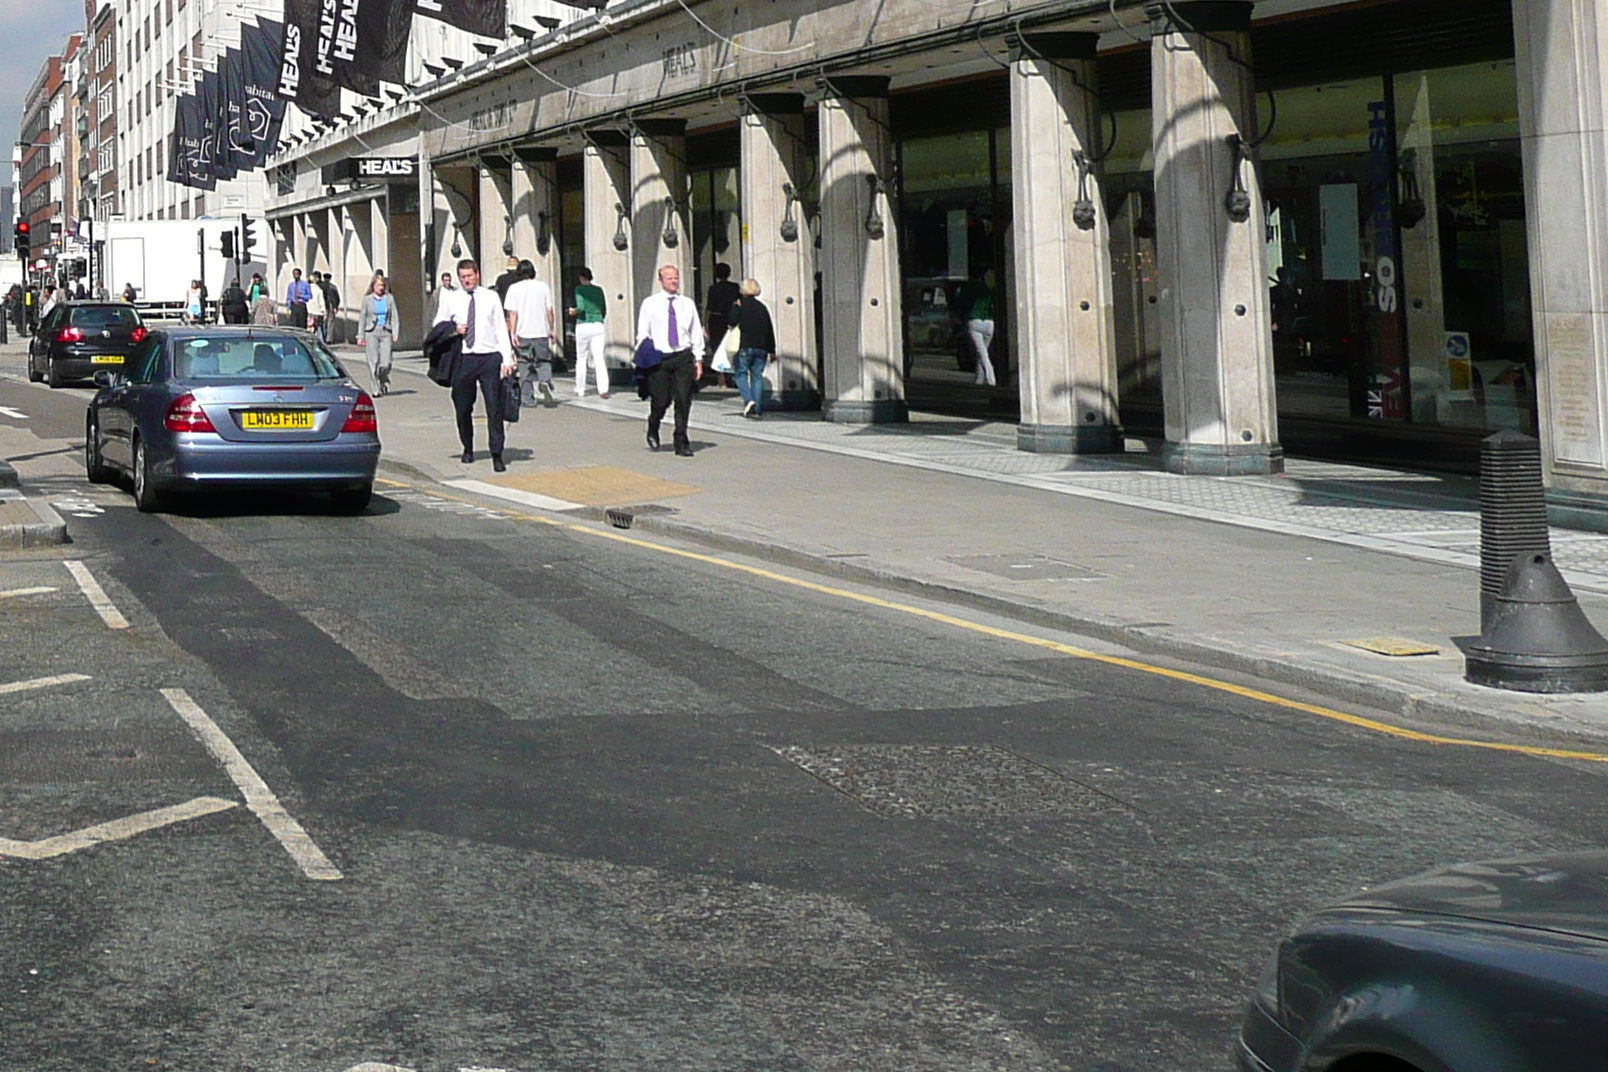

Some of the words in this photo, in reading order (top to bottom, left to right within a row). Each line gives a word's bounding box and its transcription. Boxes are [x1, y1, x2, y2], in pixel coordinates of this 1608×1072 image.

[278, 24, 301, 97] HEAL'S
[359, 159, 413, 175] HEAL'S
[248, 412, 280, 426] LW03
[283, 412, 308, 426] FHH
